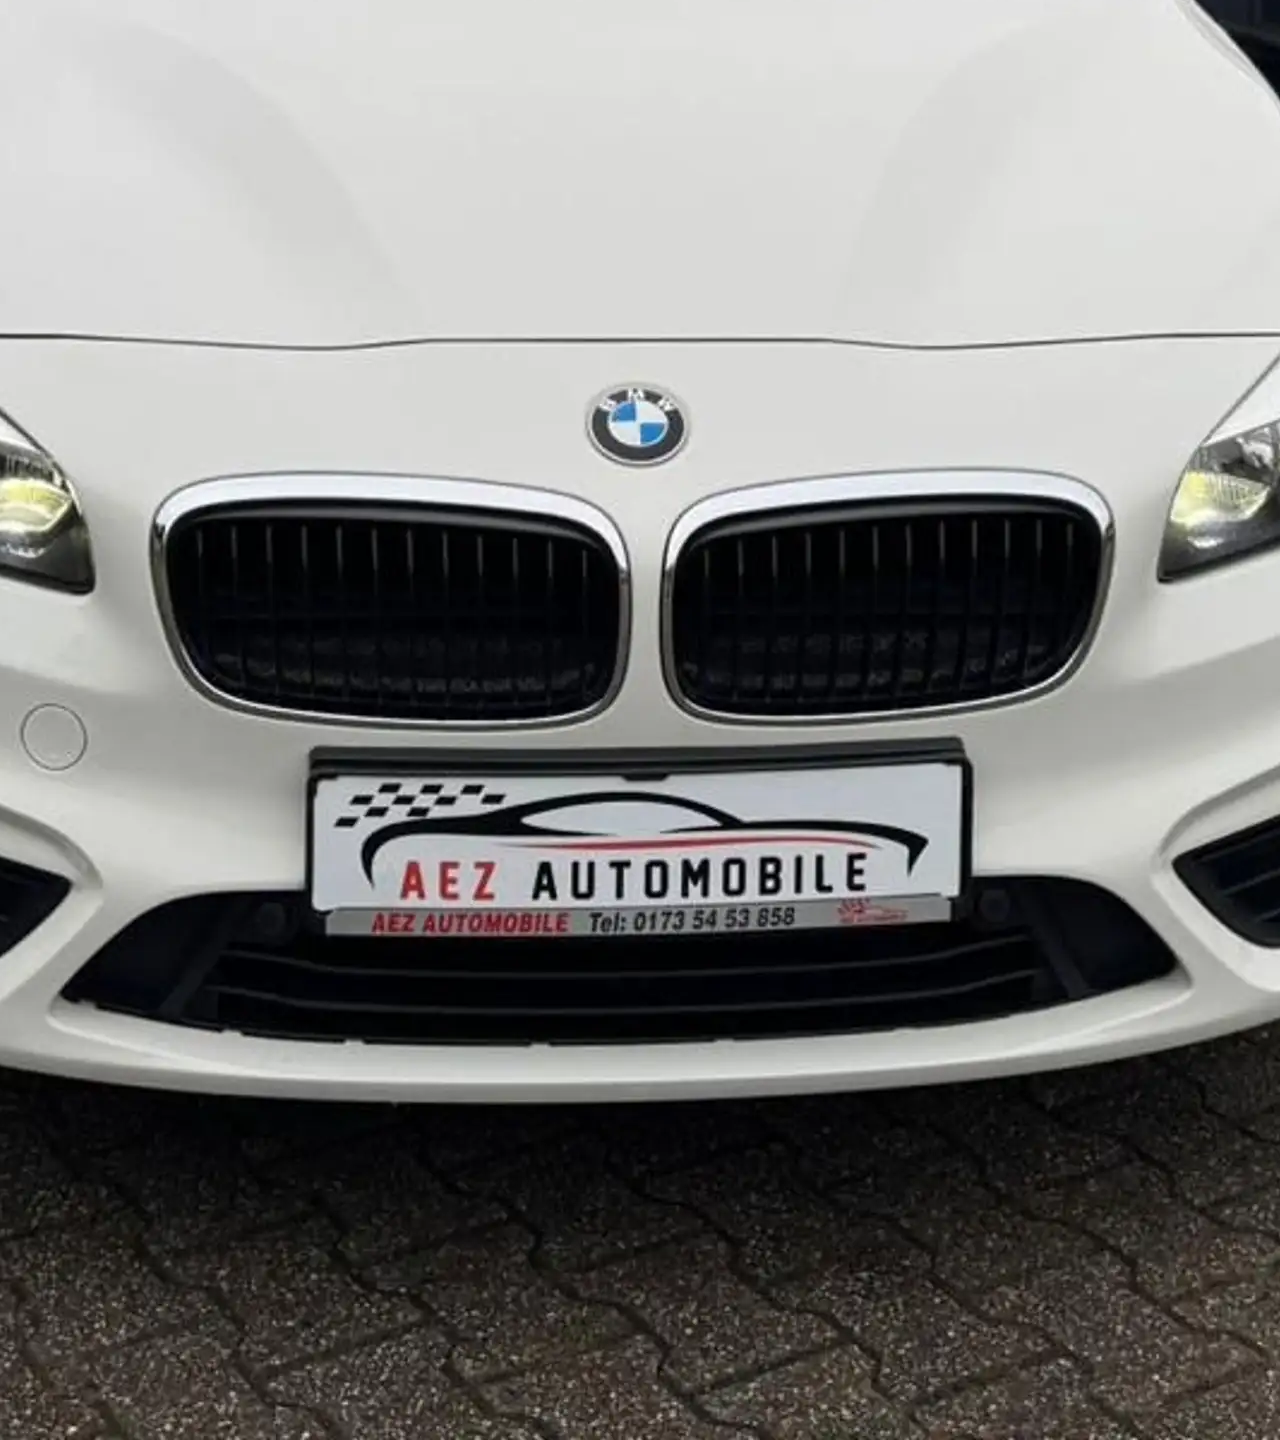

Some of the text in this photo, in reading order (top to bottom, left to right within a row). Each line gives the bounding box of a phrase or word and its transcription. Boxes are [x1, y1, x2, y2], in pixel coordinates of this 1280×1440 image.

[600, 387, 677, 412] BMW
[400, 851, 869, 902] AEZ AUTOMOBILE
[371, 906, 797, 934] AEZ AUTOMOBILE Tel: 0173 54 53 858
